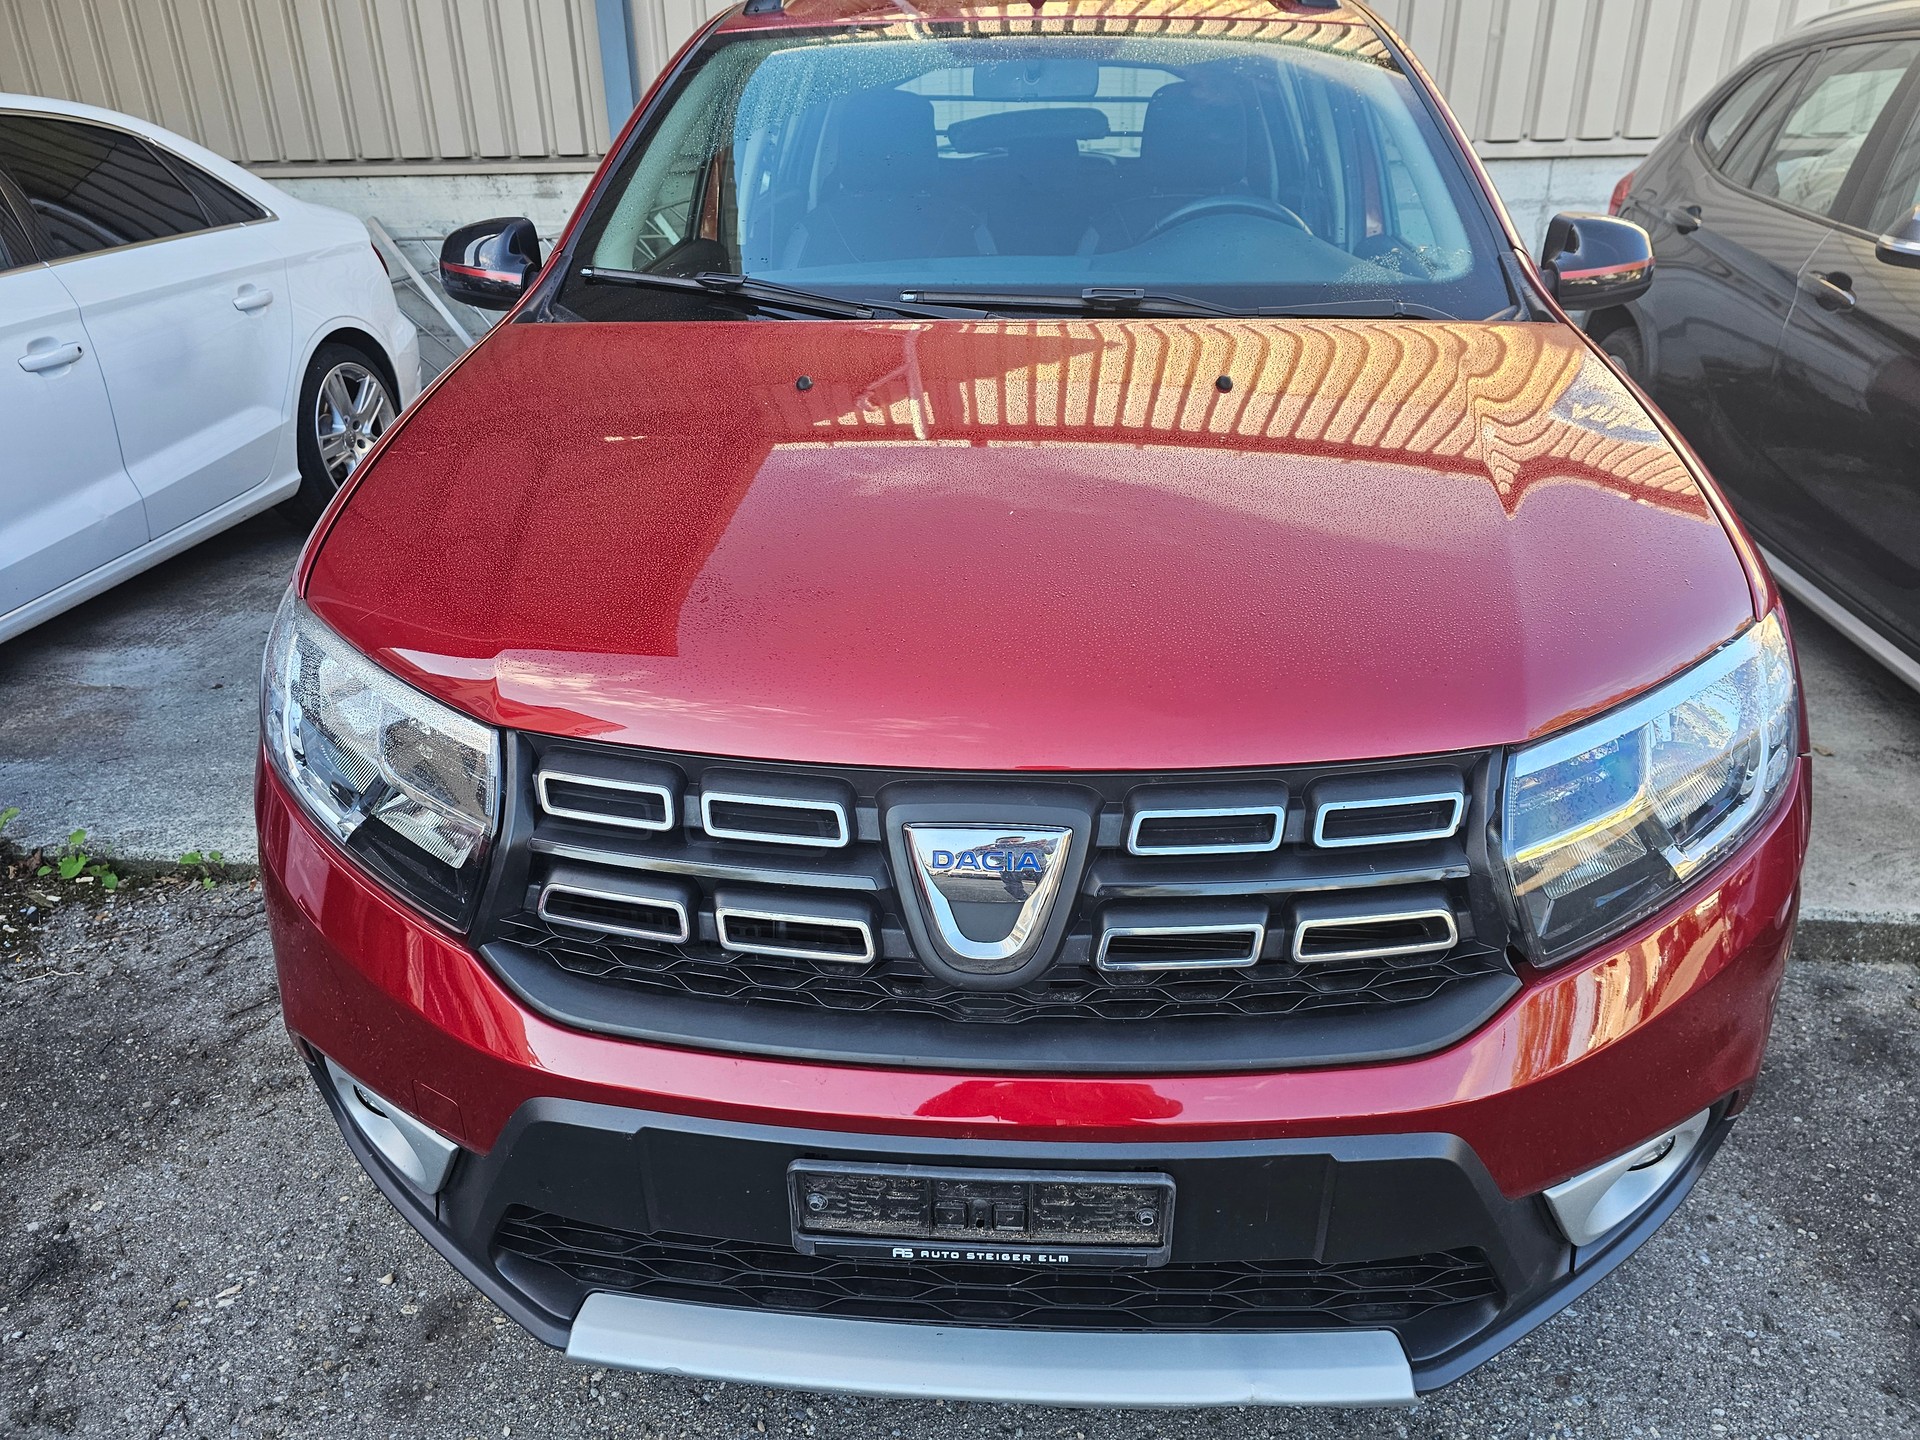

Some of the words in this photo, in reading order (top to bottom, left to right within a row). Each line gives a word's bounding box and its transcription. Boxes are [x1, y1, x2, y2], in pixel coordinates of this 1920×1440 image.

[931, 849, 1043, 873] DACIA
[920, 1250, 960, 1260] AUTO
[966, 1252, 1032, 1262] STEIGER
[1038, 1254, 1069, 1263] ELM
